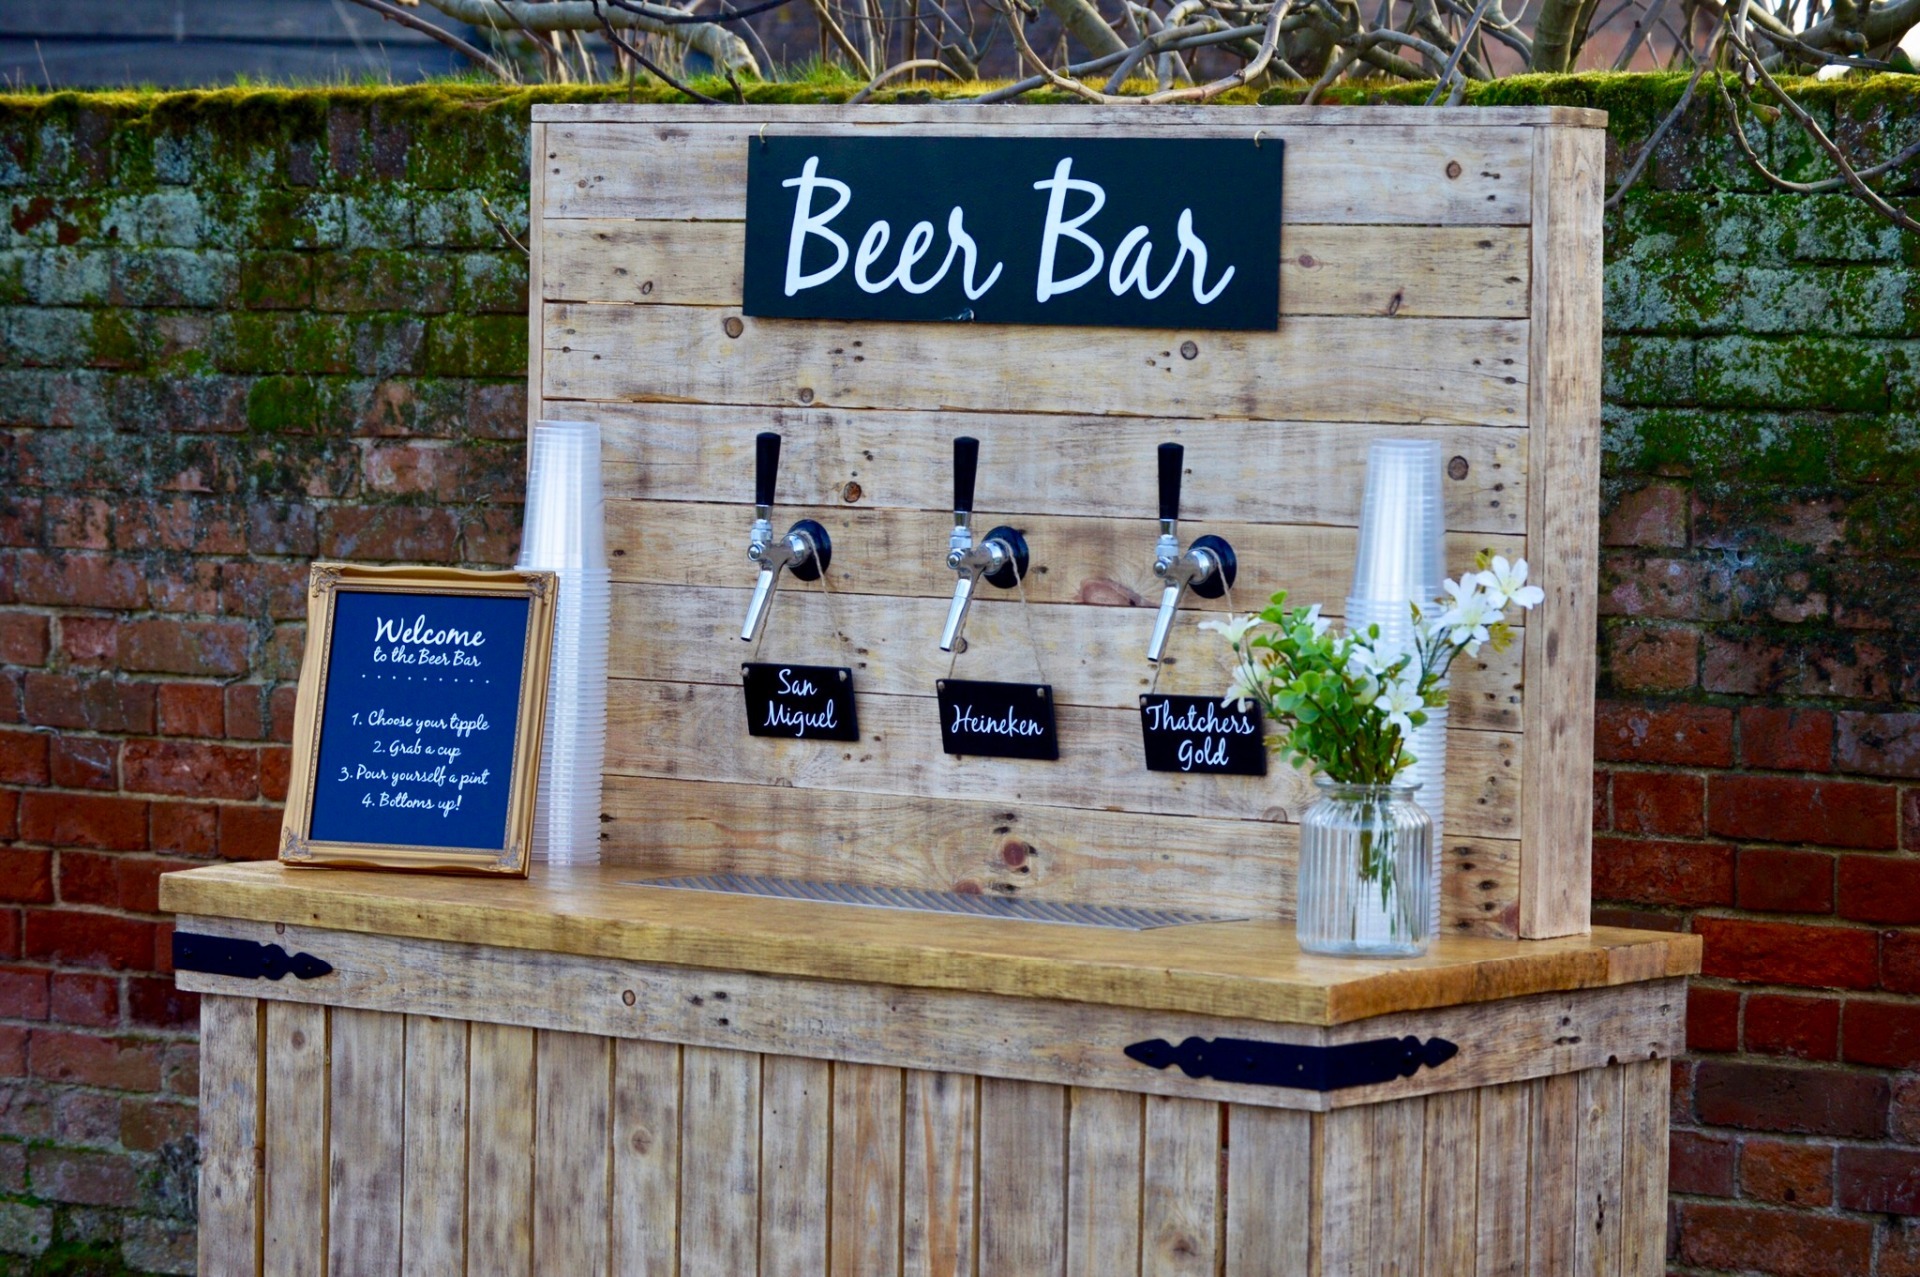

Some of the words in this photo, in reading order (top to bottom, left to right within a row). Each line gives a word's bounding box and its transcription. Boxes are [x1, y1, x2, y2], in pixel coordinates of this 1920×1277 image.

[782, 155, 1003, 301] Beer
[1033, 157, 1236, 305] Bar
[374, 614, 485, 647] Welcome
[373, 646, 387, 662] to
[391, 645, 416, 664] the
[418, 648, 450, 666] Beer
[453, 650, 481, 667] Bar
[777, 667, 817, 697] San
[351, 712, 362, 726] 1.
[368, 709, 413, 728] Choose
[415, 718, 448, 734] your
[450, 713, 490, 737] tipple
[763, 699, 838, 736] Miguel
[950, 703, 1044, 737] Heineken
[1146, 701, 1254, 736] Thatchers
[373, 741, 386, 753] 2.
[390, 739, 422, 757] Grab
[425, 746, 435, 755] a
[438, 746, 461, 764] cup
[1177, 736, 1229, 771] Gold
[338, 767, 353, 782] 3.
[356, 764, 388, 781] Pour
[391, 766, 446, 787] yourself
[449, 775, 458, 784] a
[458, 768, 490, 790] pint
[362, 793, 375, 808] 4.
[379, 791, 435, 810] Bottoms
[438, 795, 463, 817] up!
